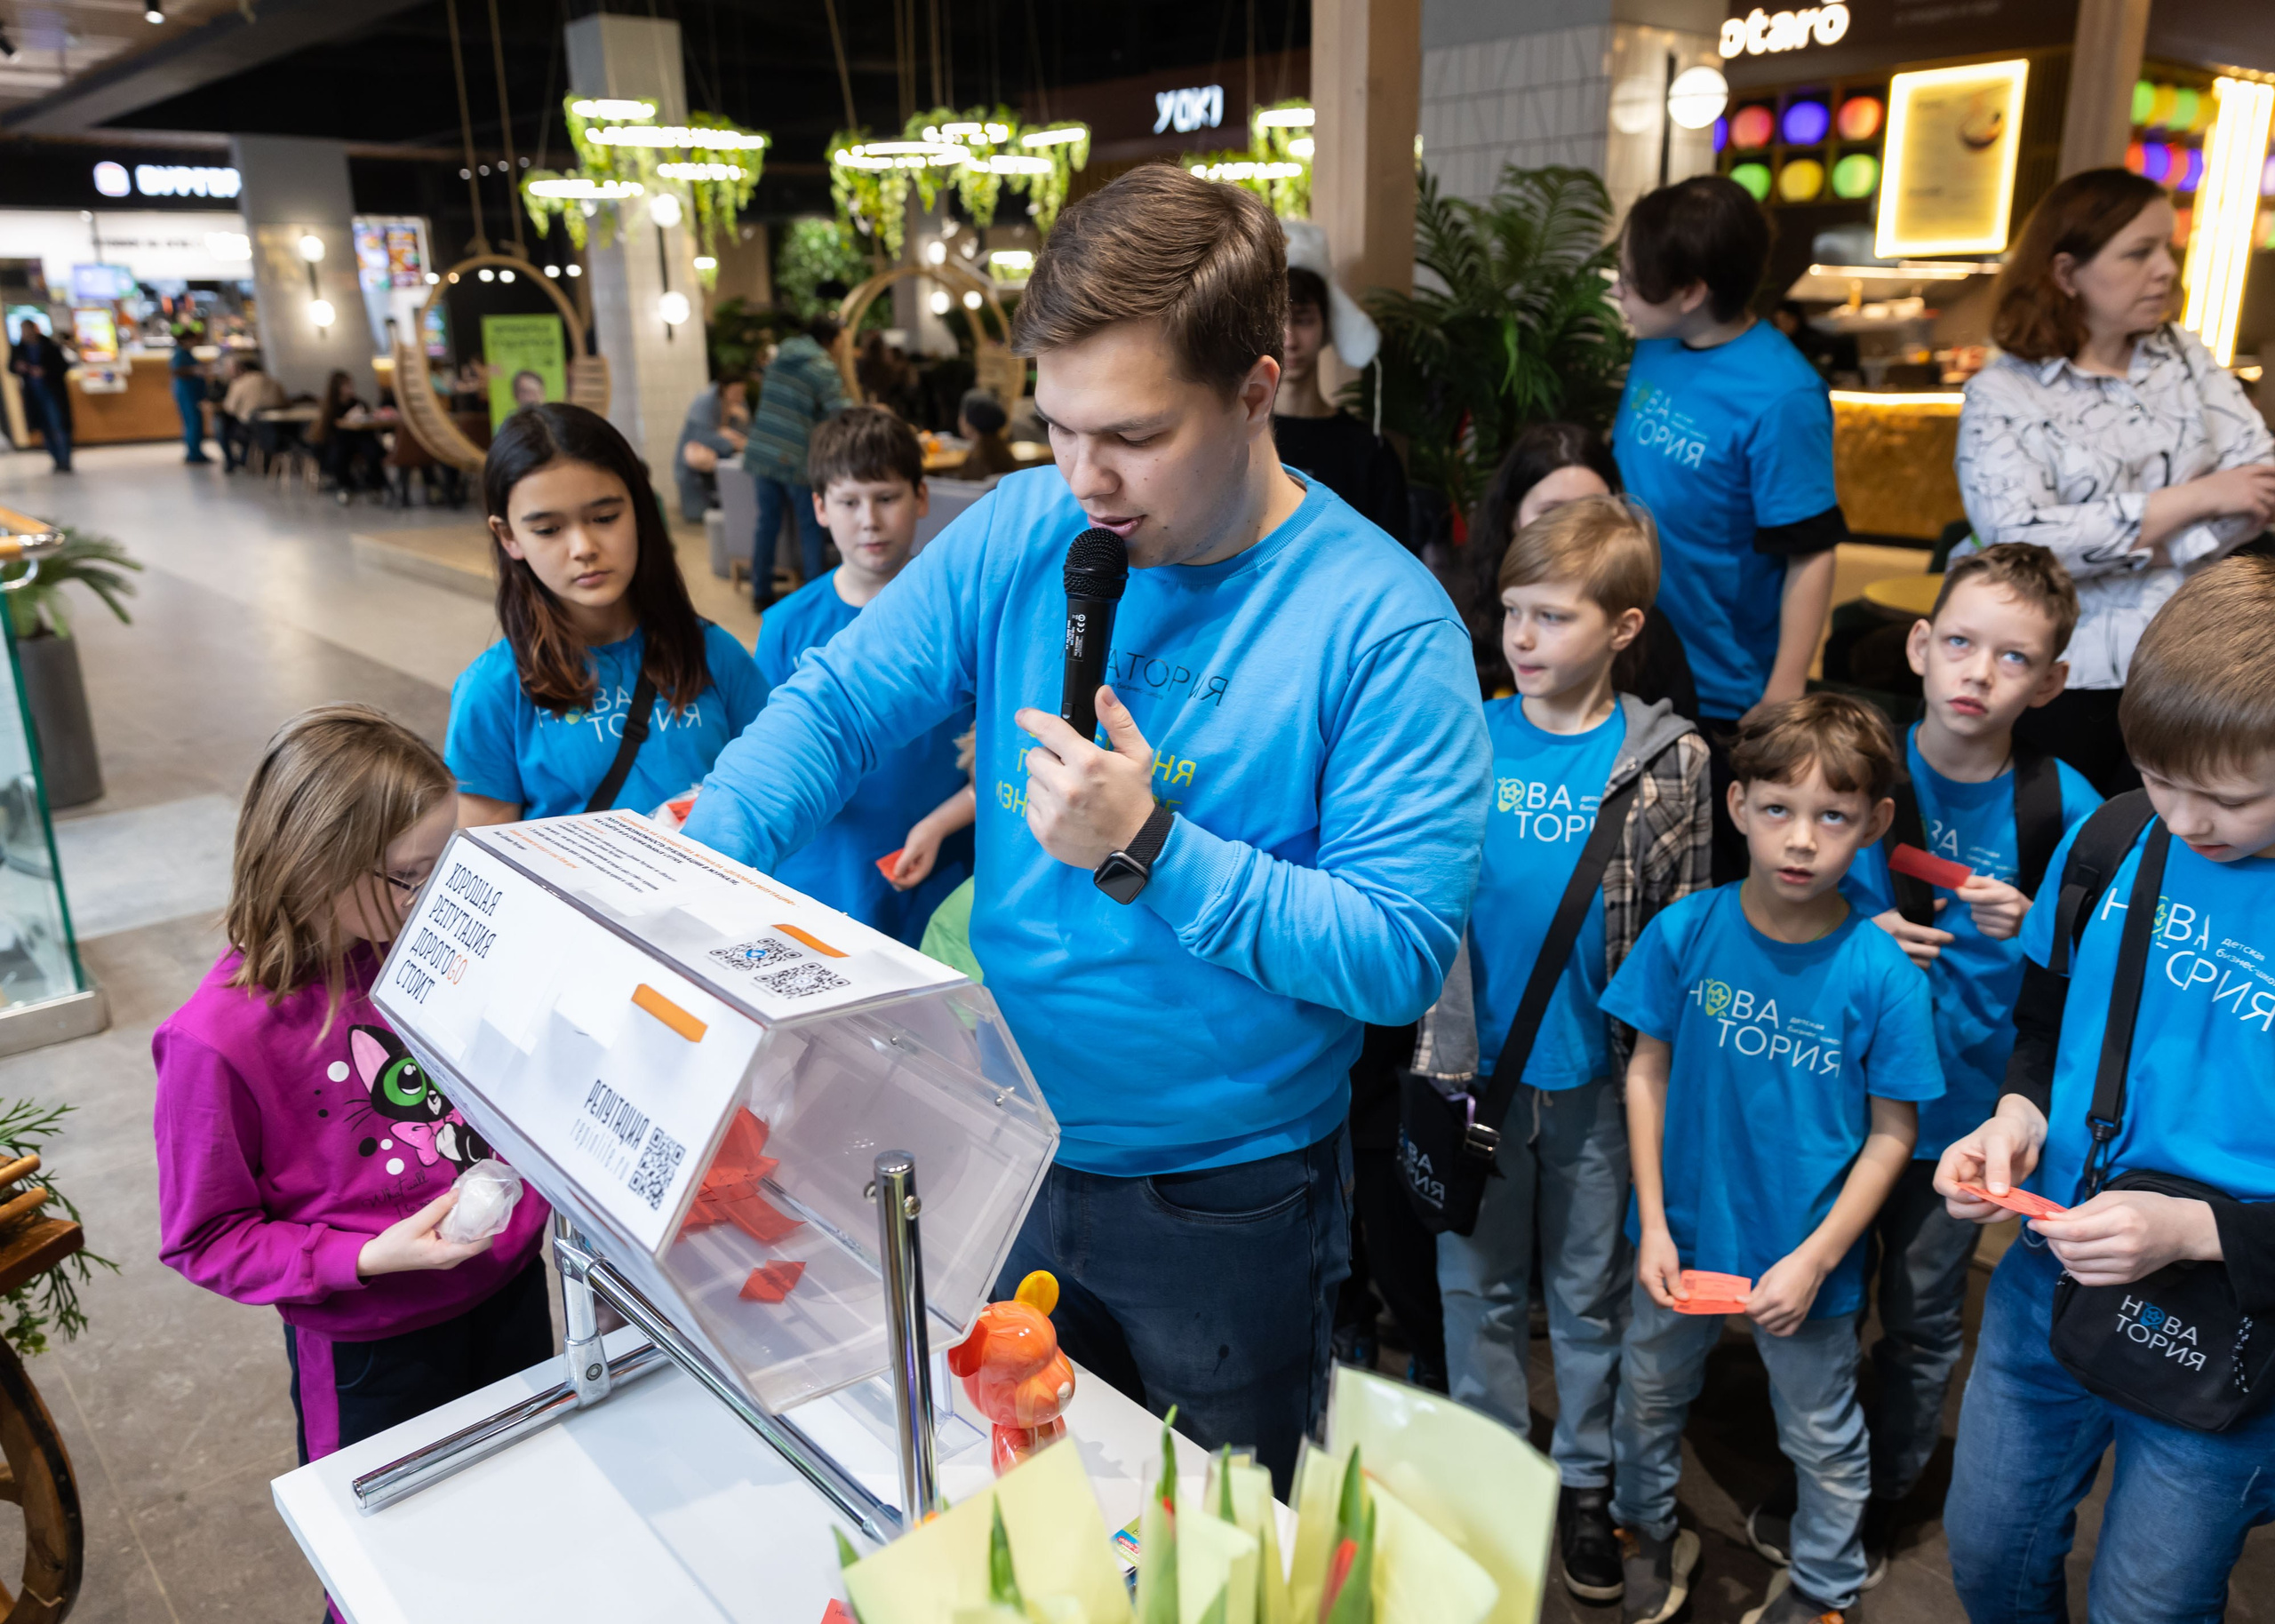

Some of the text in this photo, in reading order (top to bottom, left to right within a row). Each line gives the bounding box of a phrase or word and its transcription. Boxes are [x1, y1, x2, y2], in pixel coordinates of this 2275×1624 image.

[1108, 648, 1230, 707] АТОРИЯ
[445, 863, 503, 917] ХОРОШАЯ
[428, 894, 497, 959] РЕПУТАЦИЯ
[2221, 937, 2266, 961] детская
[395, 959, 435, 1004] СТОИТ
[2215, 948, 2275, 987] бизнес-шко
[1717, 1017, 1842, 1079] ТОРИЯ
[361, 1177, 408, 1208] What
[2115, 1313, 2207, 1372] ТОРИЯ
